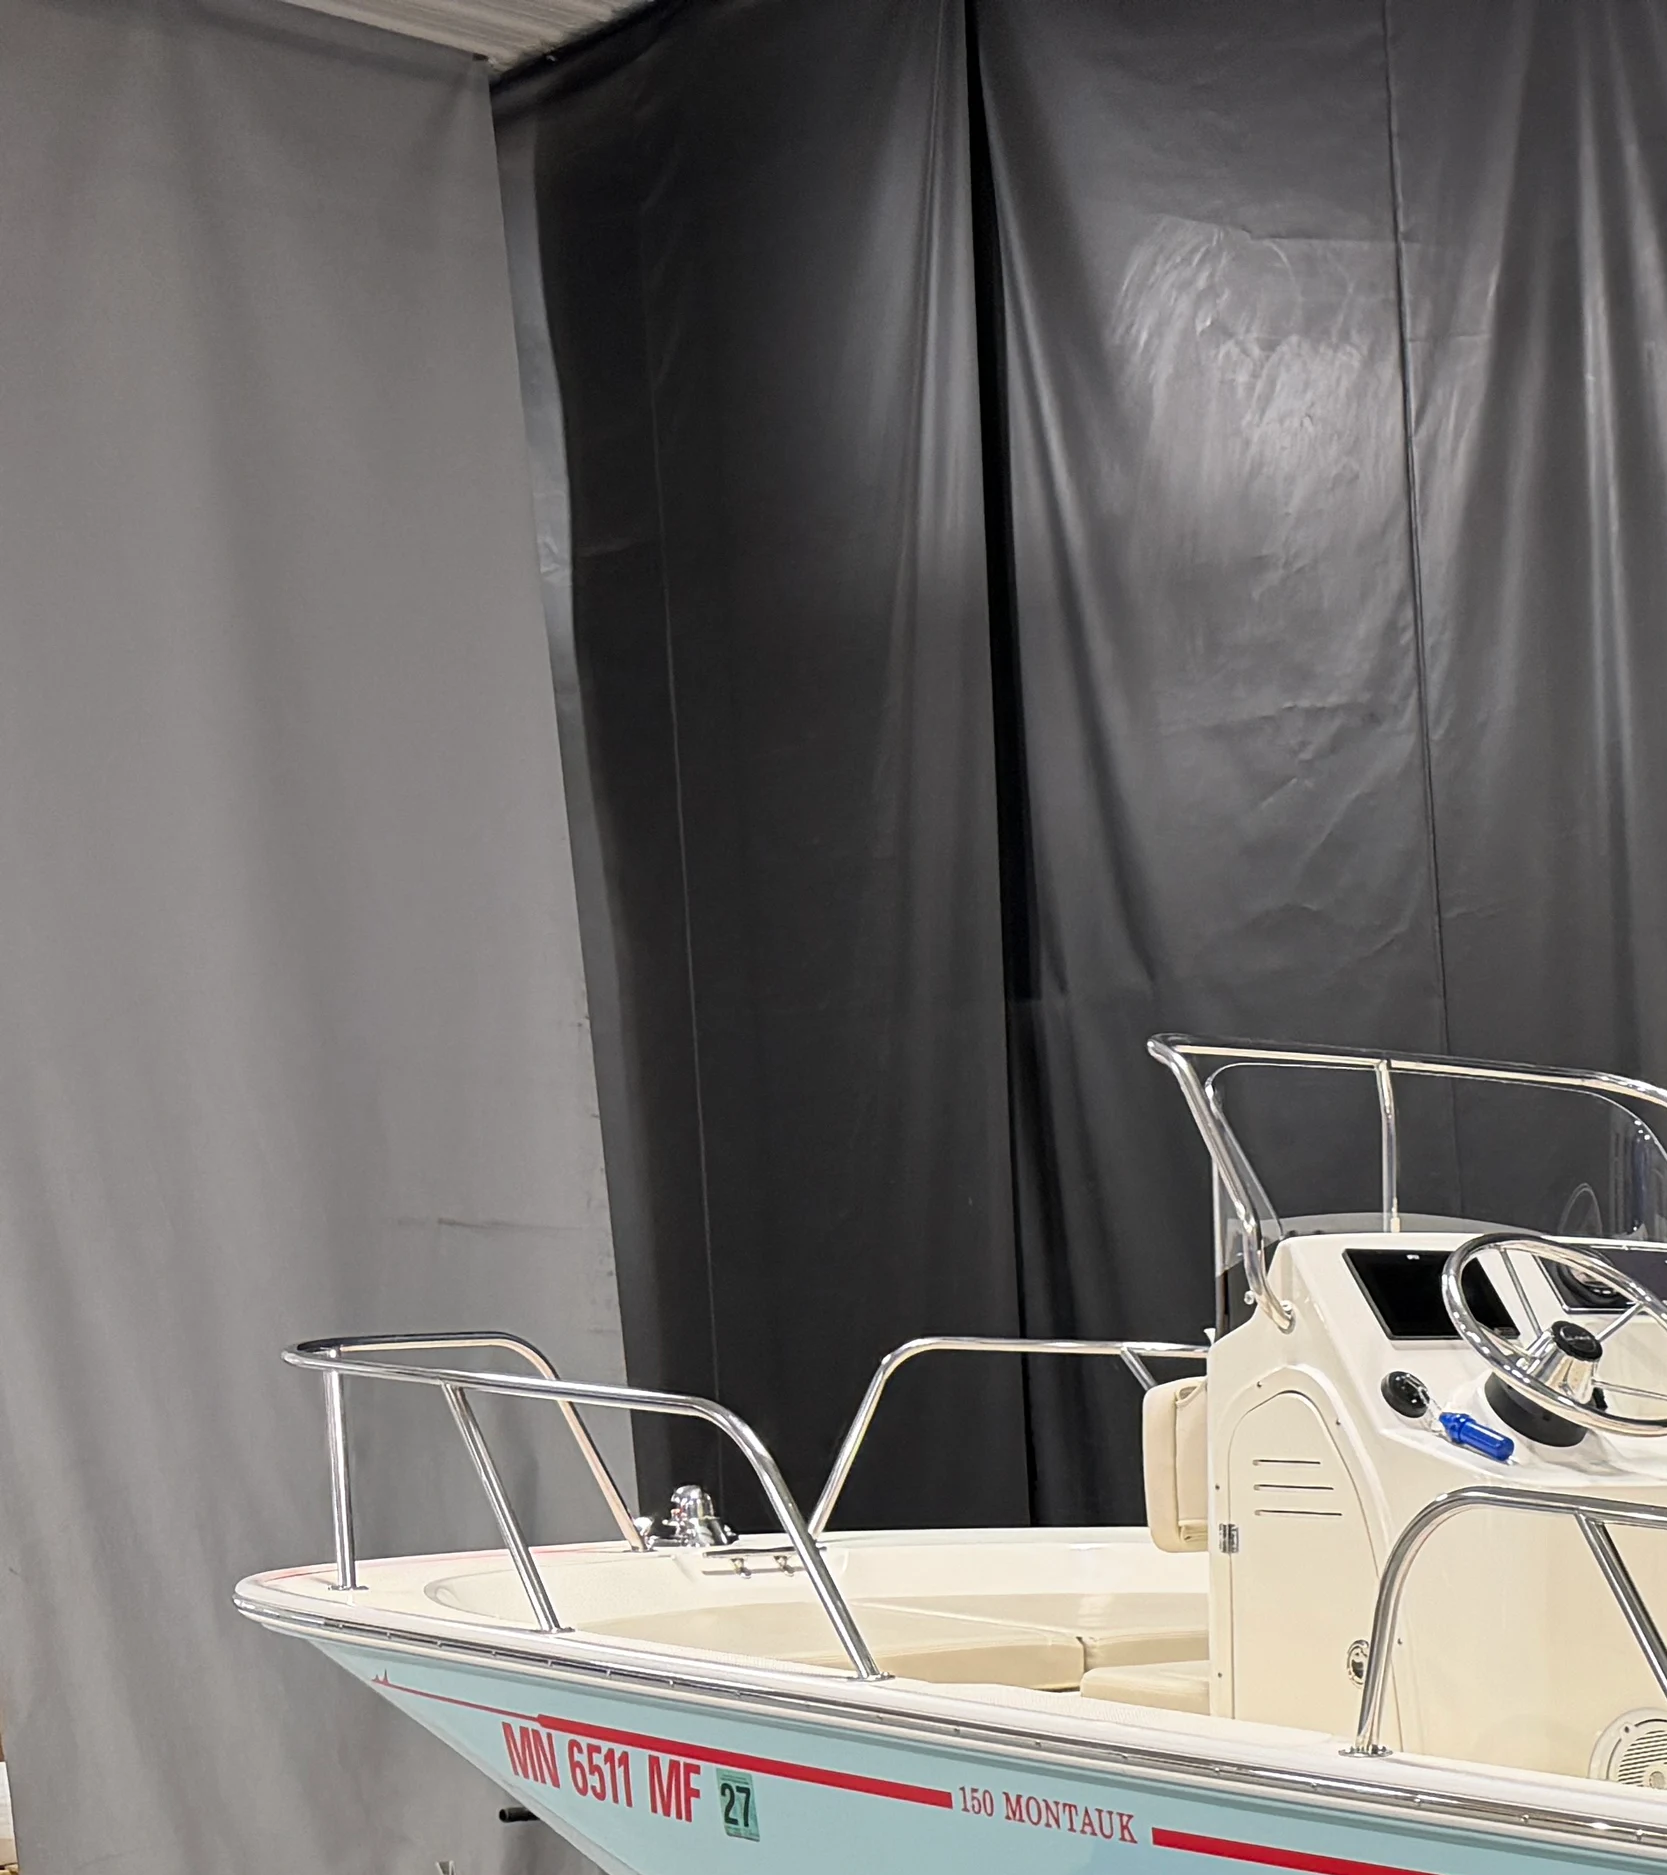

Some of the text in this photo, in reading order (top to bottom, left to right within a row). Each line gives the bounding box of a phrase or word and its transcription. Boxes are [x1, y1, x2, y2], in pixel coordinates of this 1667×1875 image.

[502, 1722, 701, 1823] MN 6511 MF
[721, 1783, 751, 1827] 27
[959, 1786, 1138, 1844] 150 MONTAUK
